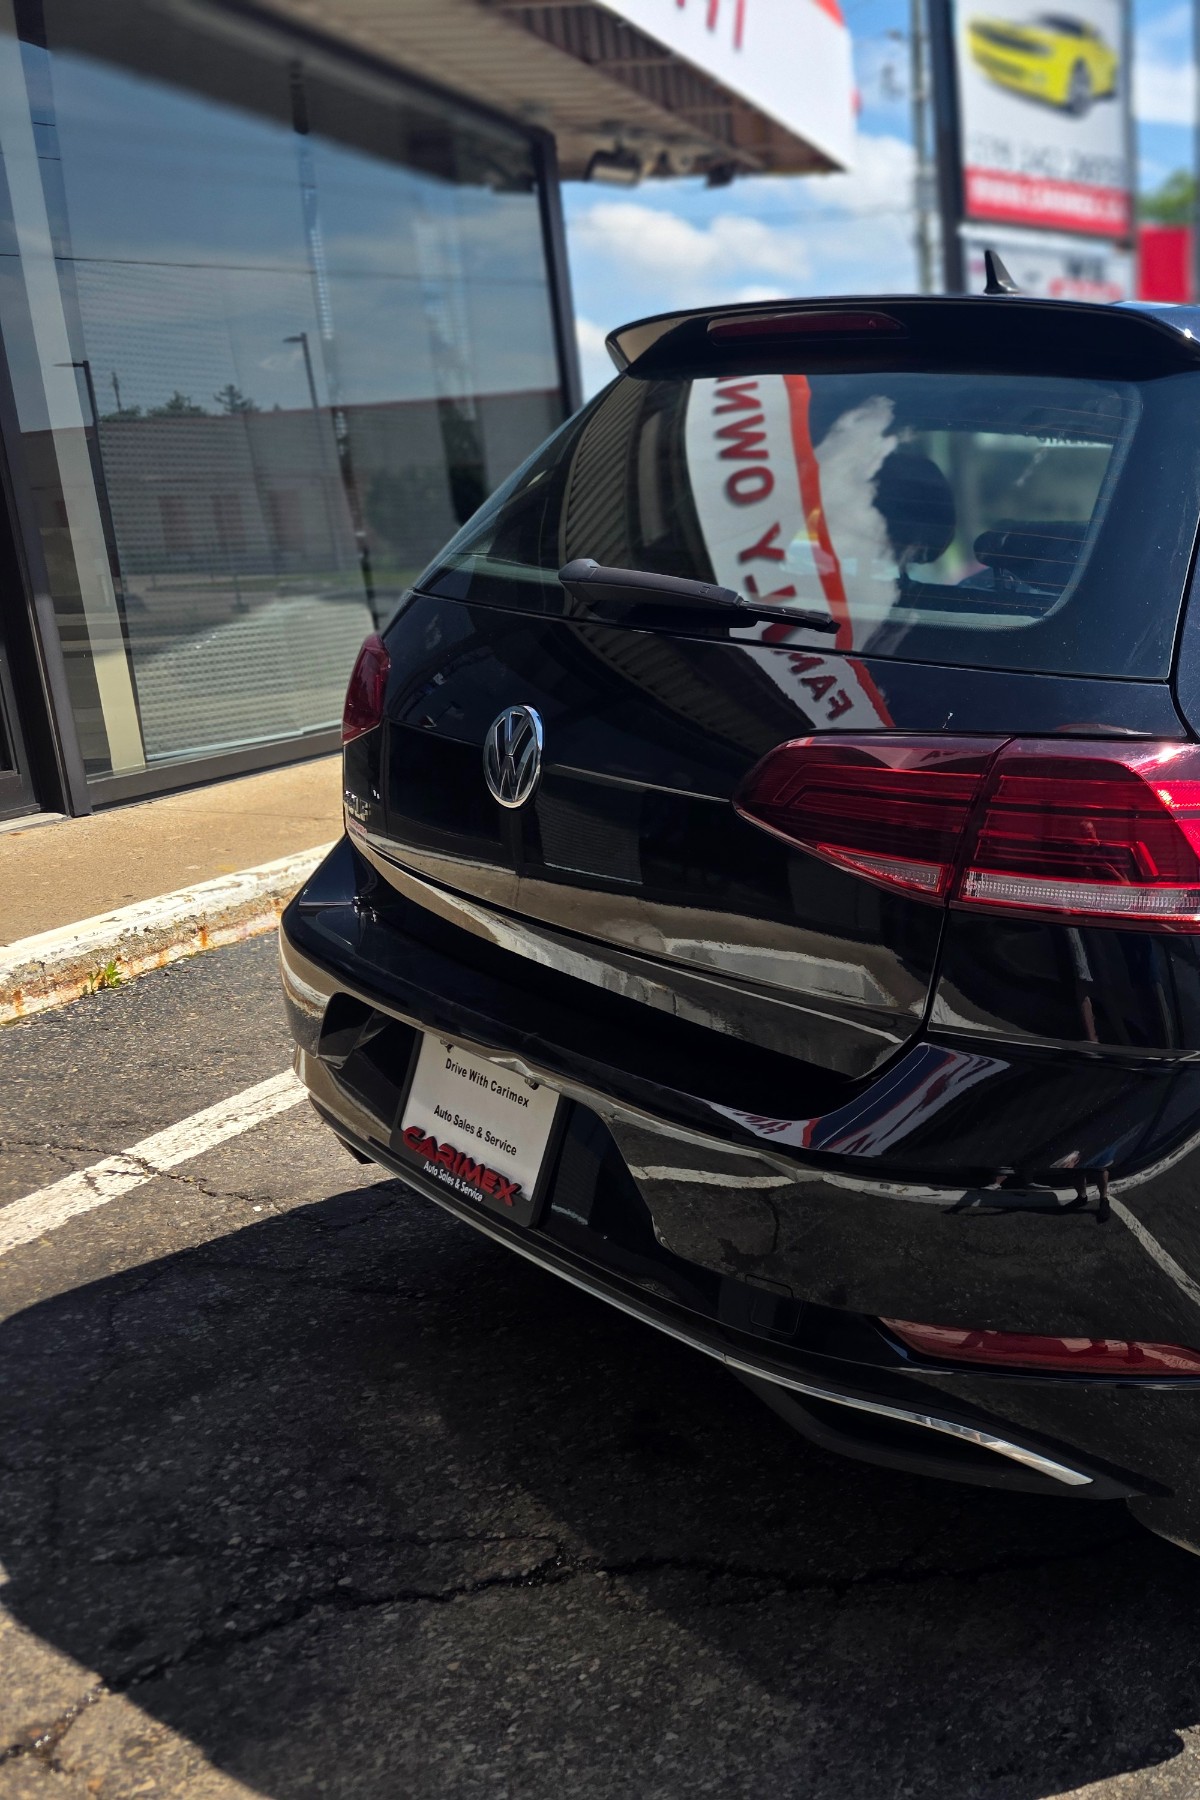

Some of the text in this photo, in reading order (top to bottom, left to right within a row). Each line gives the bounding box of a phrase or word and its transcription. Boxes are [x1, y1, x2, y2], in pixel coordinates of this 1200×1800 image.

[445, 1058, 530, 1107] Drive With Carimex
[434, 1104, 517, 1156] Auto Sales & Service
[402, 1125, 522, 1207] CARIMEX
[423, 1160, 483, 1202] Auto Sales & Service
